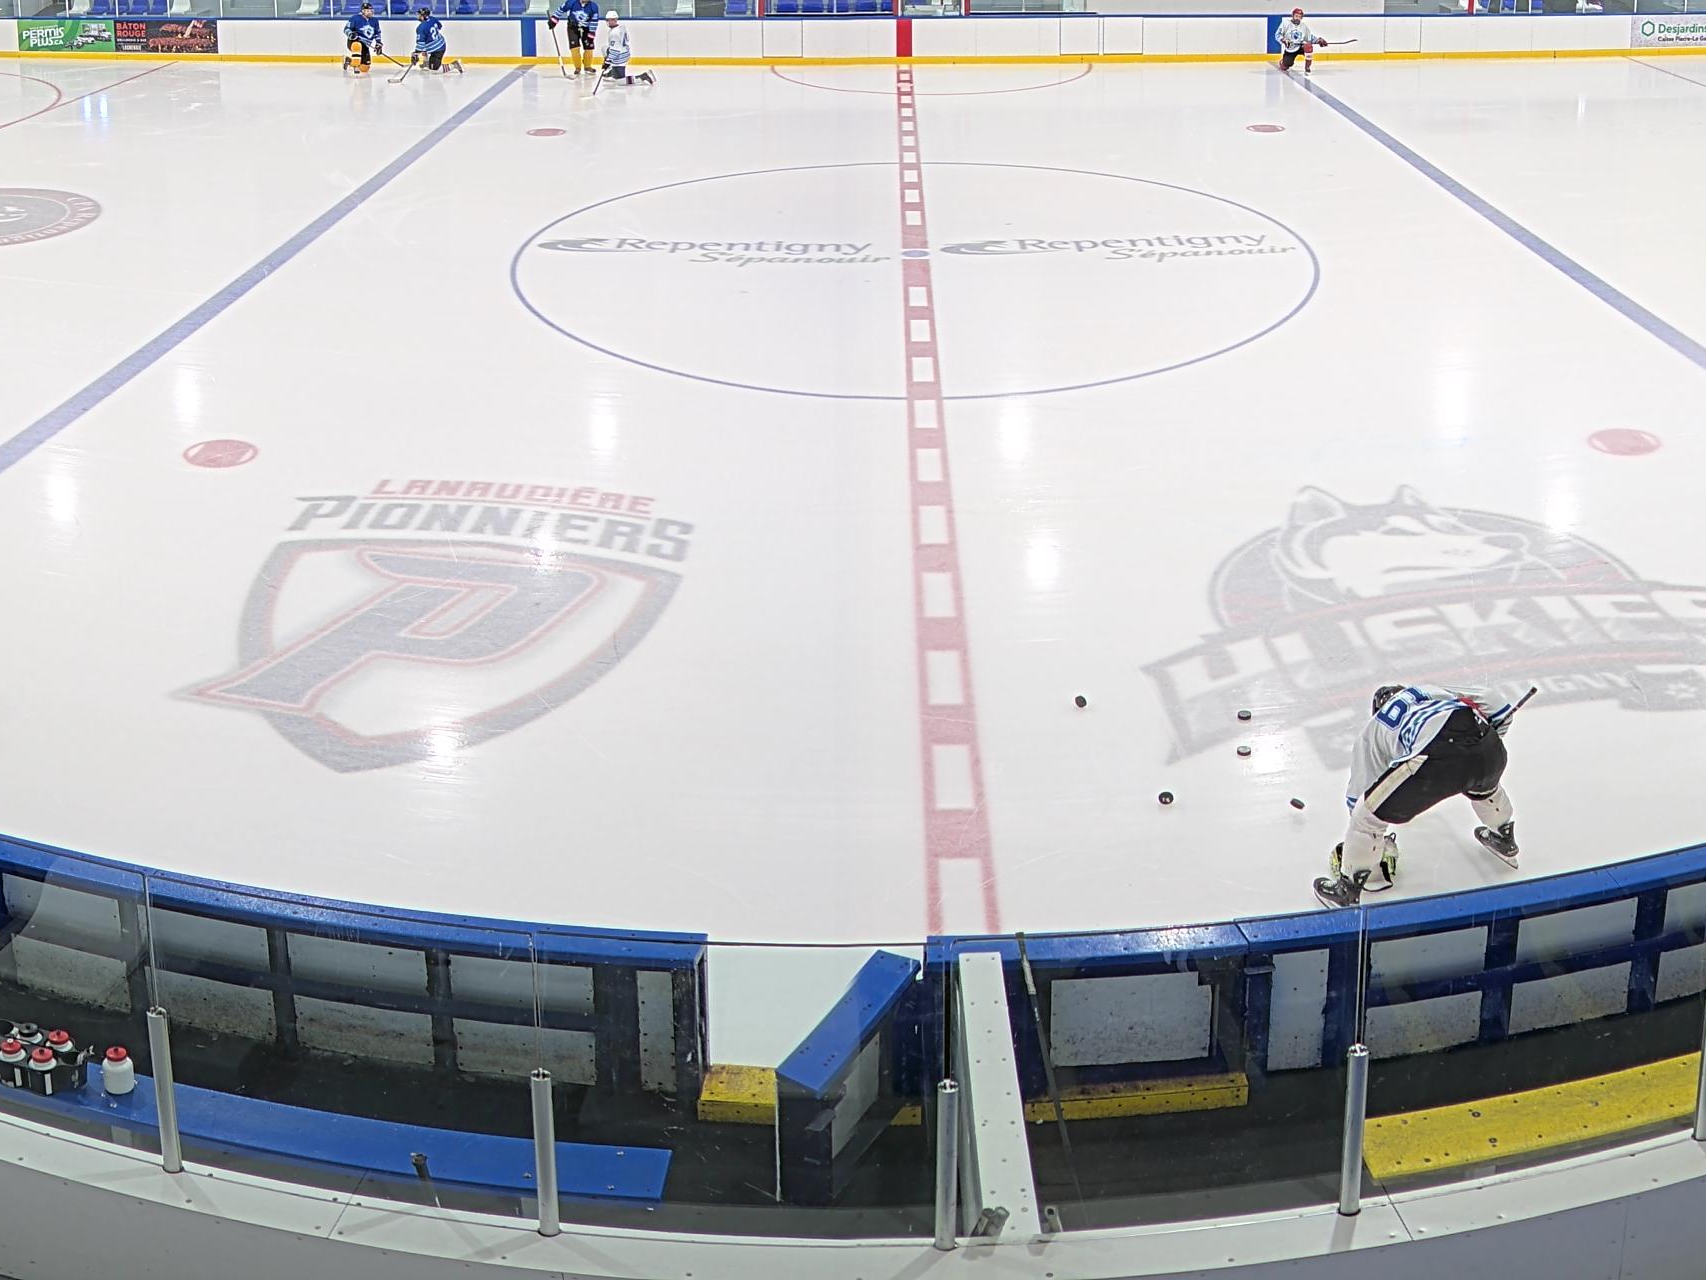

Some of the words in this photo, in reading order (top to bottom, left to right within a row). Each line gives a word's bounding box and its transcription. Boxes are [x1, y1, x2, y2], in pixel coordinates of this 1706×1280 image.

[22, 26, 65, 39] PERMIS
[116, 22, 146, 30] BÂTON
[30, 37, 63, 47] PLUS.CA
[615, 235, 873, 257] Repentigny
[1008, 230, 1270, 252] Repentigny
[368, 478, 656, 515] LANAUDIÈRE
[285, 494, 695, 563] PIONNIERS
